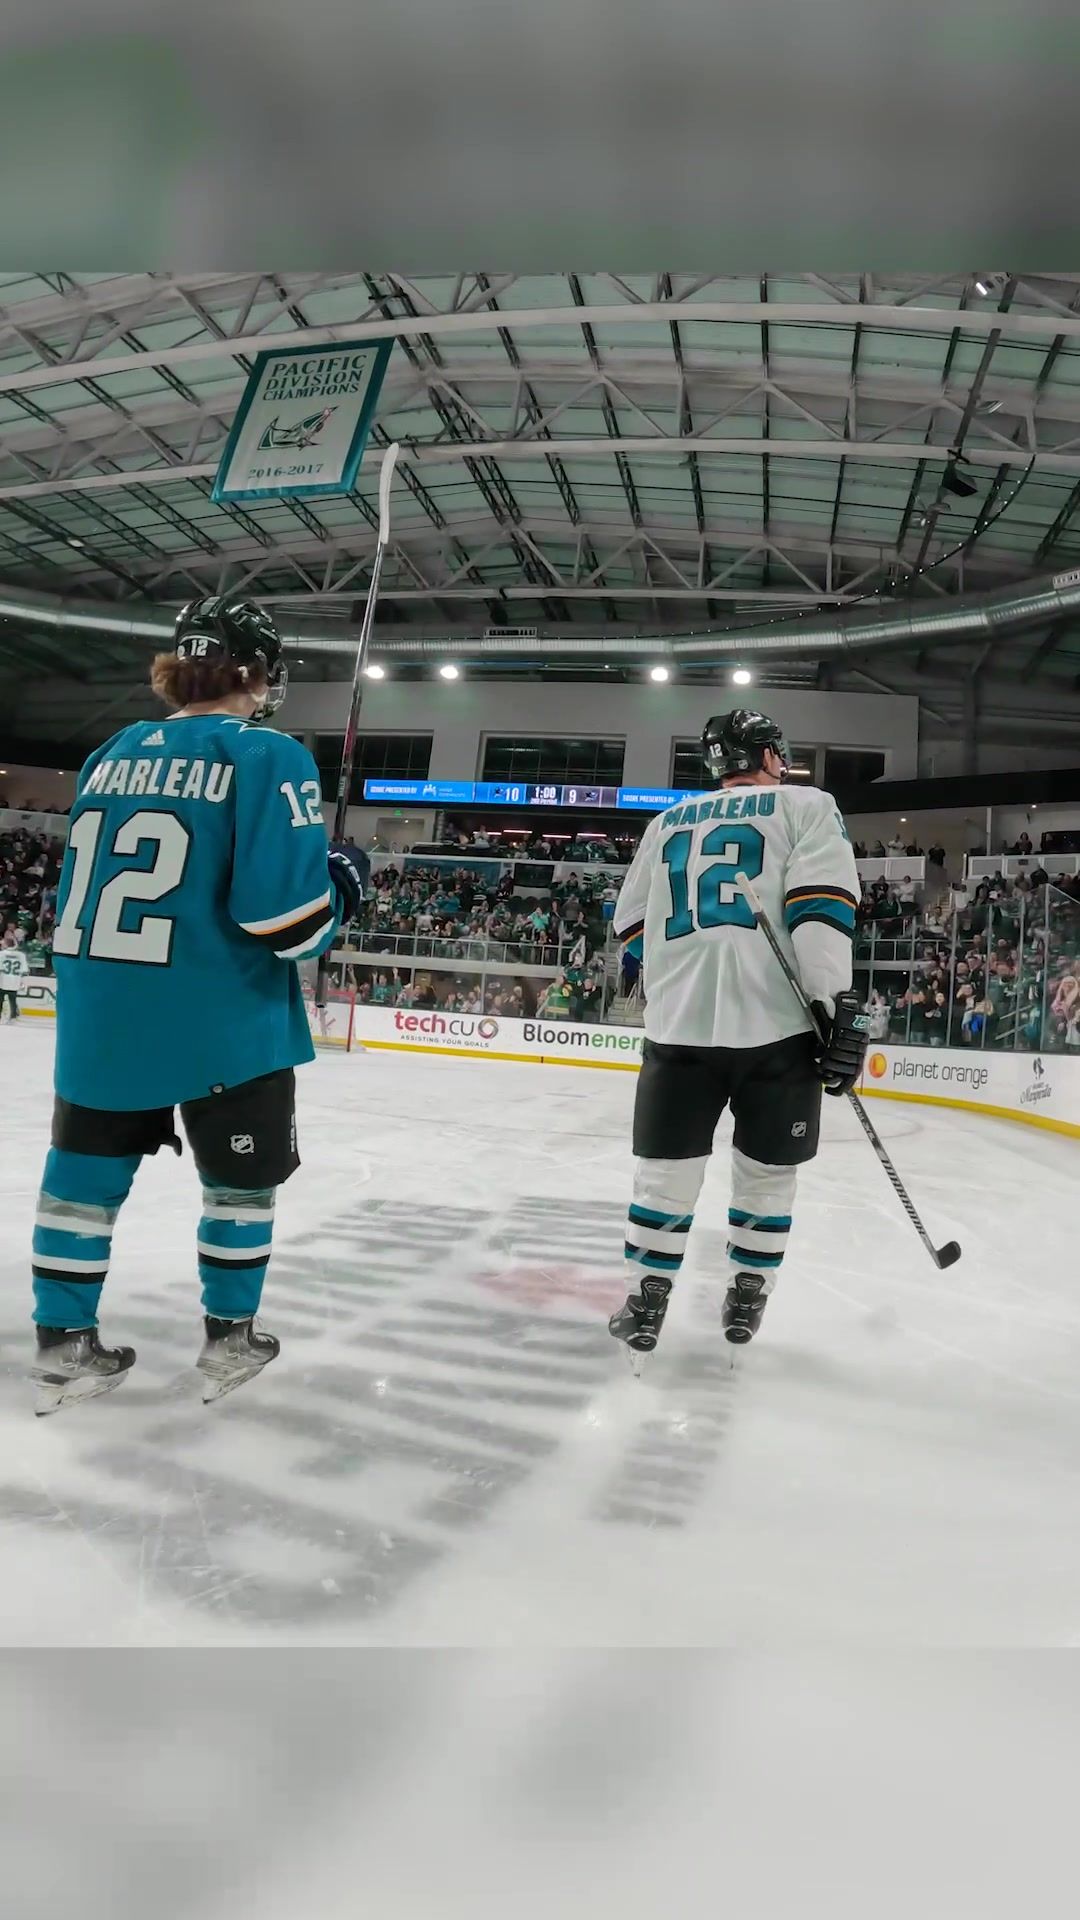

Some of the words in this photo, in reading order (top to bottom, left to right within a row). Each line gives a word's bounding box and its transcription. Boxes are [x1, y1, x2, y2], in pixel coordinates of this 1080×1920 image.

[272, 354, 367, 377] PACIFIC
[265, 370, 362, 391] DIVISION
[263, 382, 359, 401] CHAMPIONS
[248, 463, 324, 479] 2016-2017
[190, 639, 208, 656] 12
[709, 743, 722, 758] 12
[81, 757, 234, 803] MARLEAU
[505, 787, 519, 802] 10
[534, 786, 556, 799] 1:00
[569, 789, 577, 804] 9
[279, 780, 325, 828] 12
[661, 792, 776, 831] MARLEAU
[51, 808, 192, 967] 12
[662, 823, 765, 941] 12
[2, 959, 21, 976] 32
[400, 1034, 439, 1043] ASSISTING
[442, 1038, 462, 1046] YOUR
[523, 1023, 643, 1052] Bloomener
[893, 1058, 938, 1080] planet
[941, 1065, 988, 1090] orange
